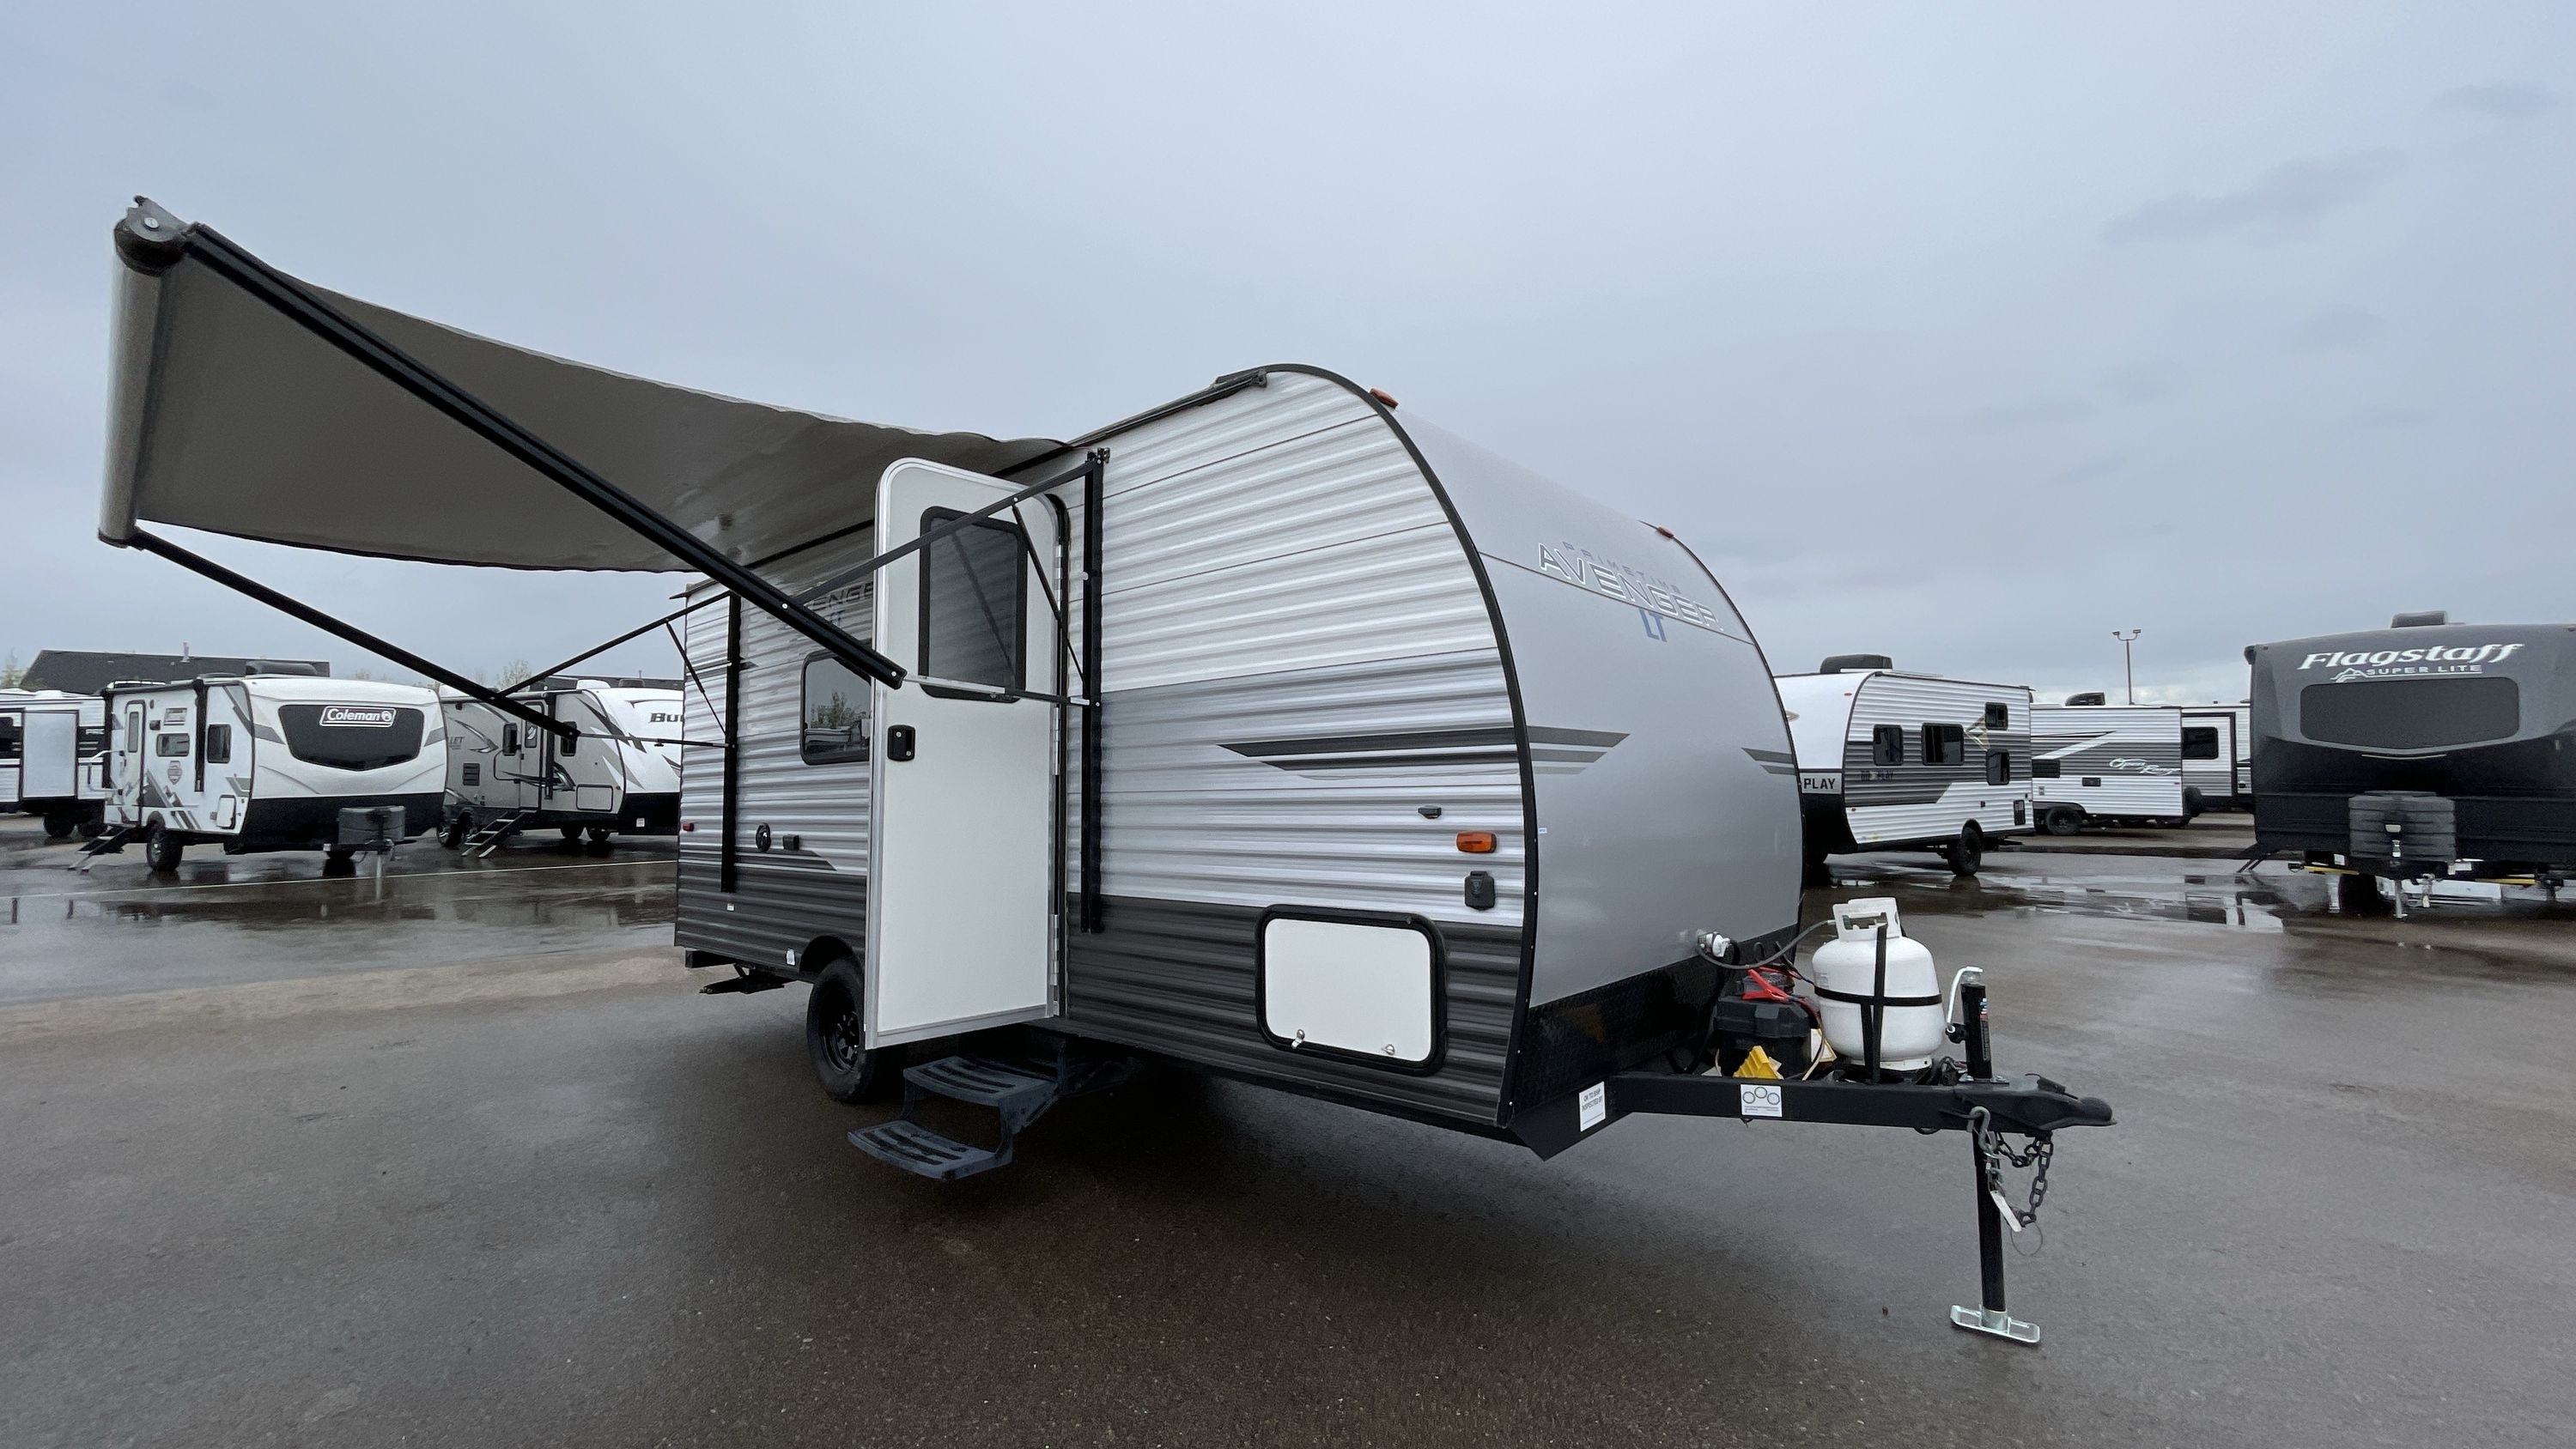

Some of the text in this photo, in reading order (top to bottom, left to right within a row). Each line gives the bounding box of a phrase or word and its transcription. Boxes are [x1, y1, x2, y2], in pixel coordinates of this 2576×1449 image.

[1539, 543, 1724, 632] AVENGER
[1639, 609, 1668, 643] LT
[2297, 643, 2524, 670] Flagstaff
[2366, 664, 2482, 676] SUPER LITE
[326, 708, 380, 721] Coleman
[1803, 778, 1836, 790] PLAY
